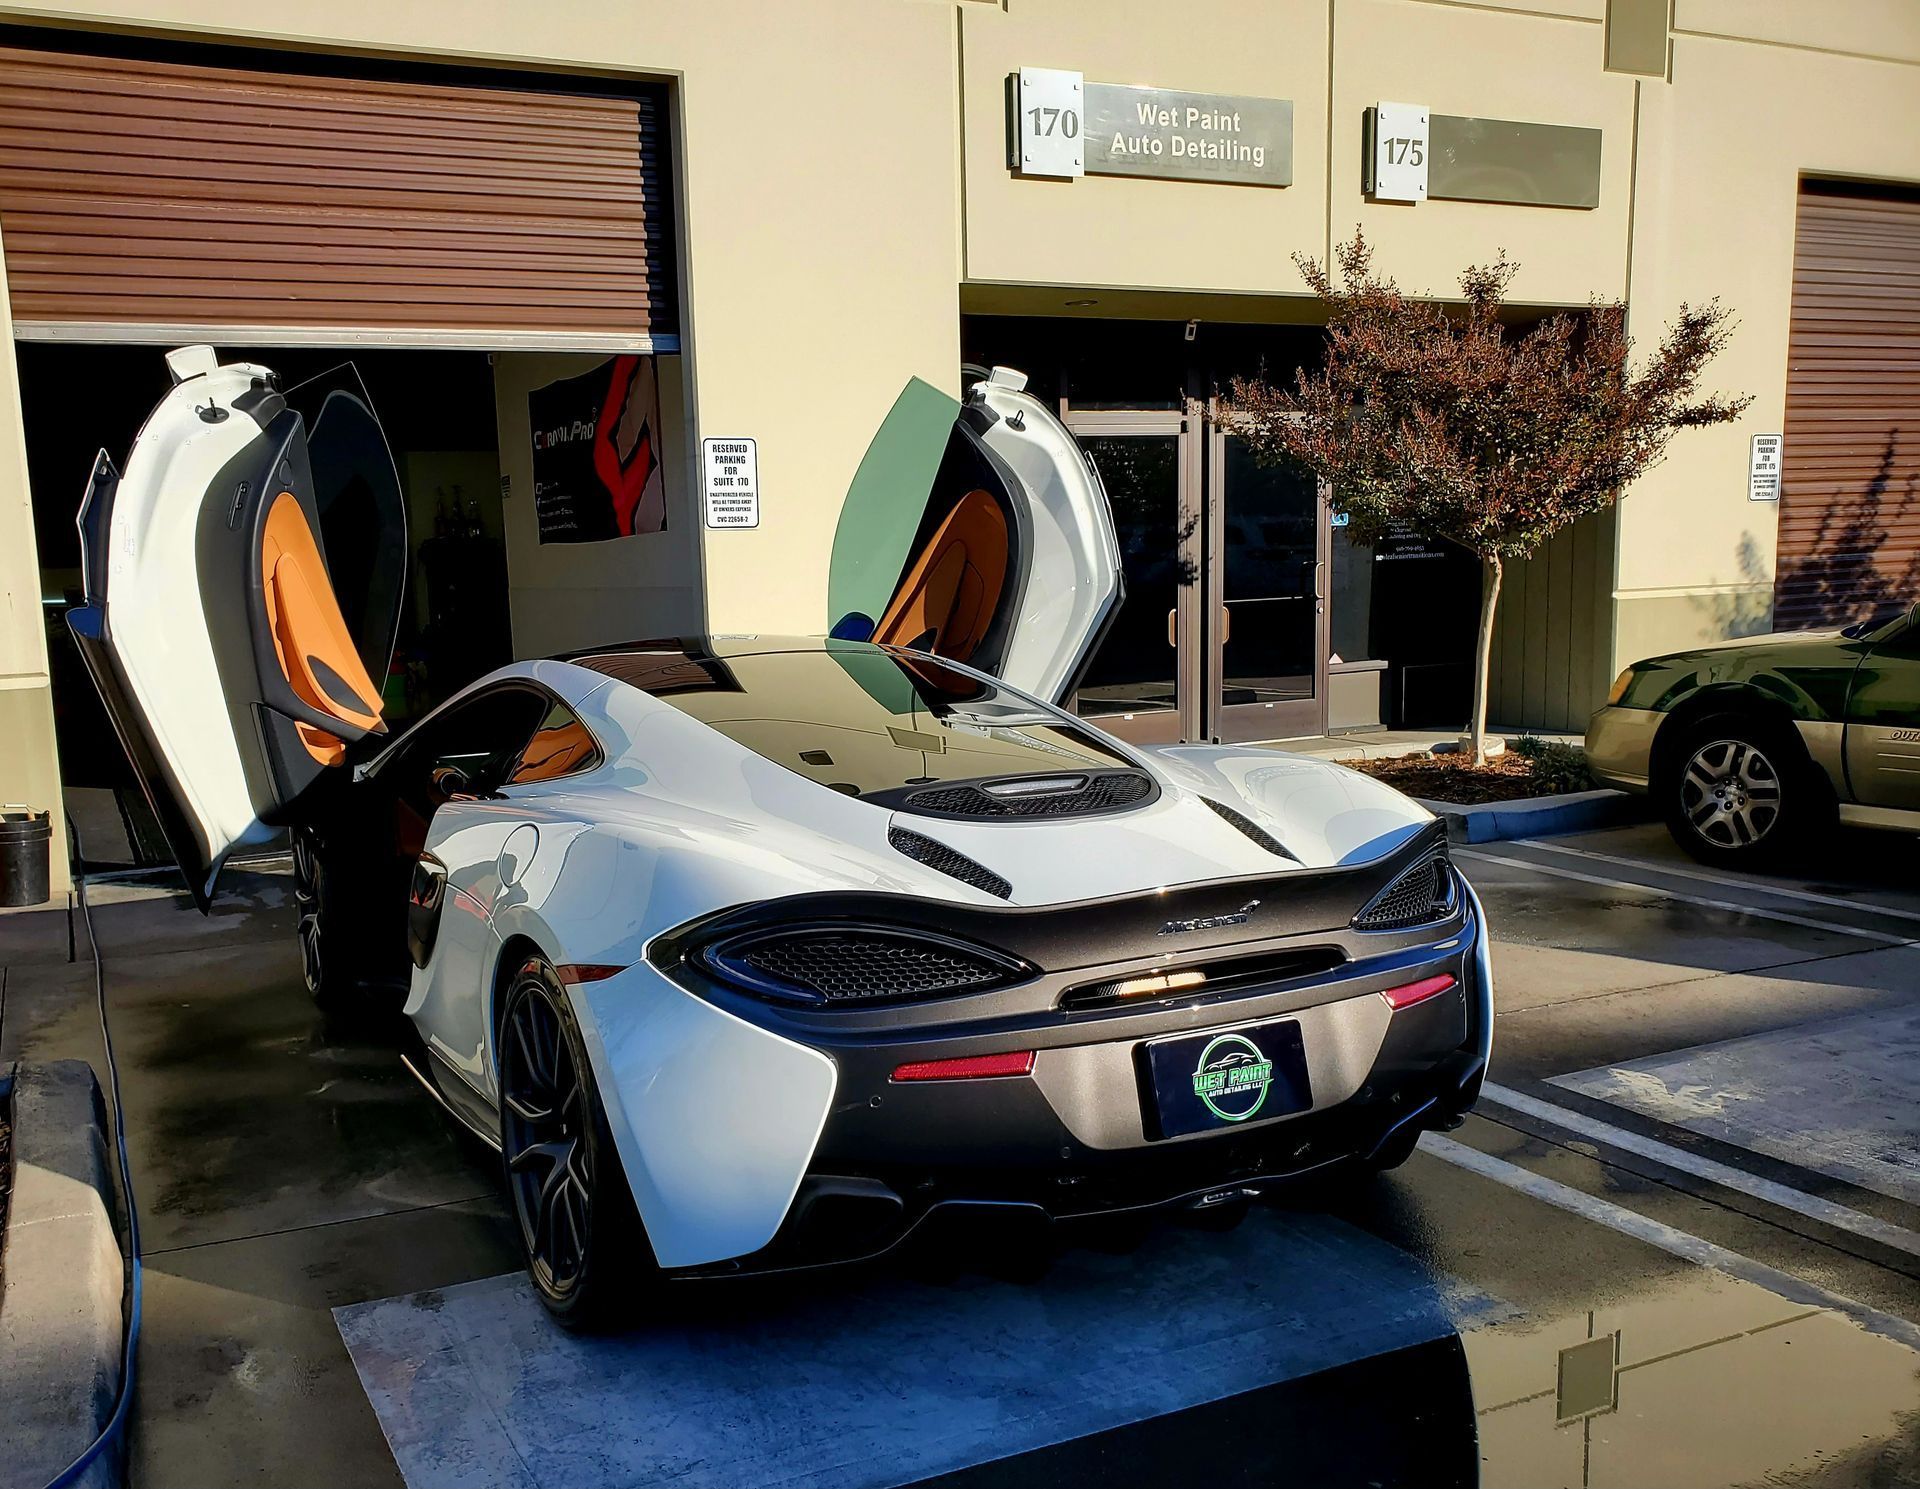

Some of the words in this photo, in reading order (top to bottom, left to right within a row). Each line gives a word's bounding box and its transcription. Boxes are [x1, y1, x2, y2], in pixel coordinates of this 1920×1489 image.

[1027, 107, 1079, 138] 170
[1136, 102, 1179, 129] Wet
[1186, 107, 1241, 132] Paint
[1110, 132, 1163, 155] Auto
[1171, 135, 1265, 167] Detailing
[1383, 137, 1424, 167] 175
[712, 444, 748, 453] RESERVED
[715, 455, 746, 464] PARKING
[724, 466, 738, 475] FOR
[713, 477, 734, 486] SUITE
[737, 477, 749, 486] 170
[1891, 730, 1920, 742] OUT
[1156, 913, 1248, 936] McLaren
[1193, 1071, 1227, 1092] WET
[1228, 1062, 1272, 1087] PAINT
[1208, 1088, 1224, 1097] AUTO
[1223, 1083, 1252, 1094] DETAILING
[1252, 1081, 1263, 1089] LLC
